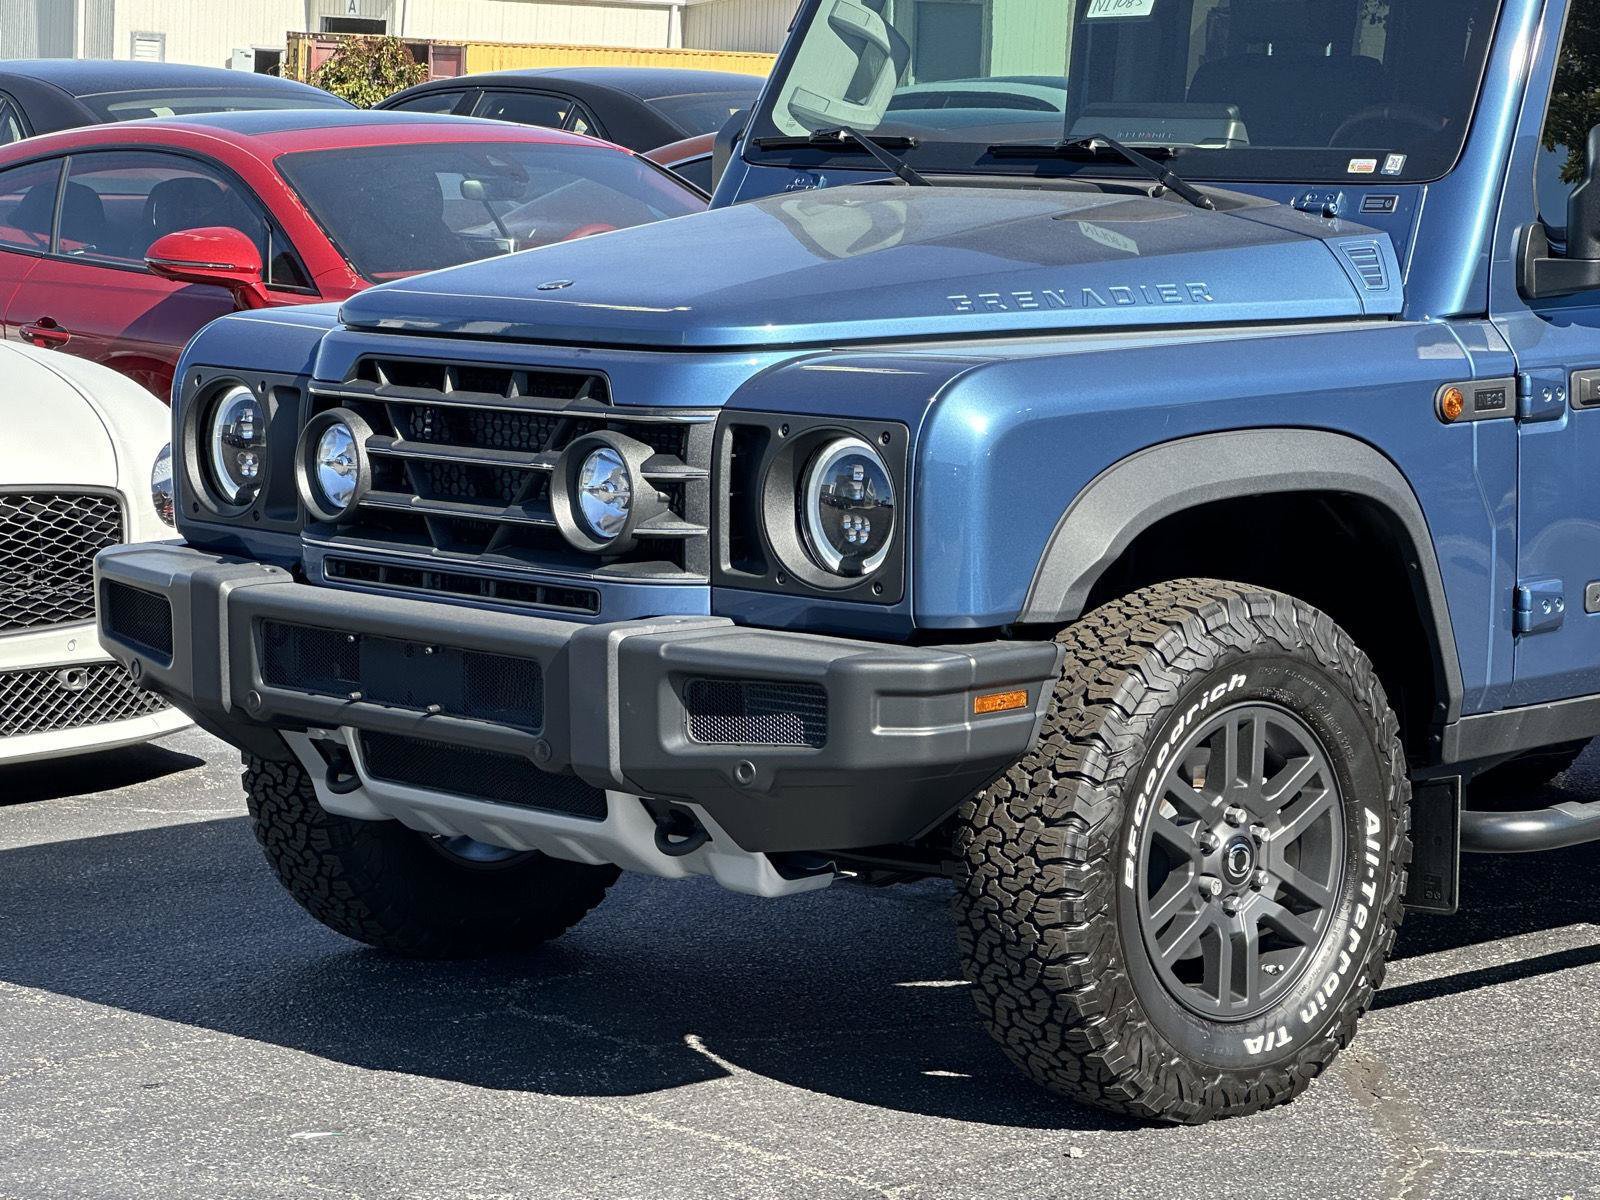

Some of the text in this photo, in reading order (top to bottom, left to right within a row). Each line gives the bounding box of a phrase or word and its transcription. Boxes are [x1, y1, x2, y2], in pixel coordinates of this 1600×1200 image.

[348, 0, 356, 13] A
[947, 282, 1216, 311] GRENADIER
[1125, 673, 1246, 889] BFGoodrich
[1301, 807, 1381, 1024] All-Terrain
[1243, 1025, 1293, 1055] T/A
